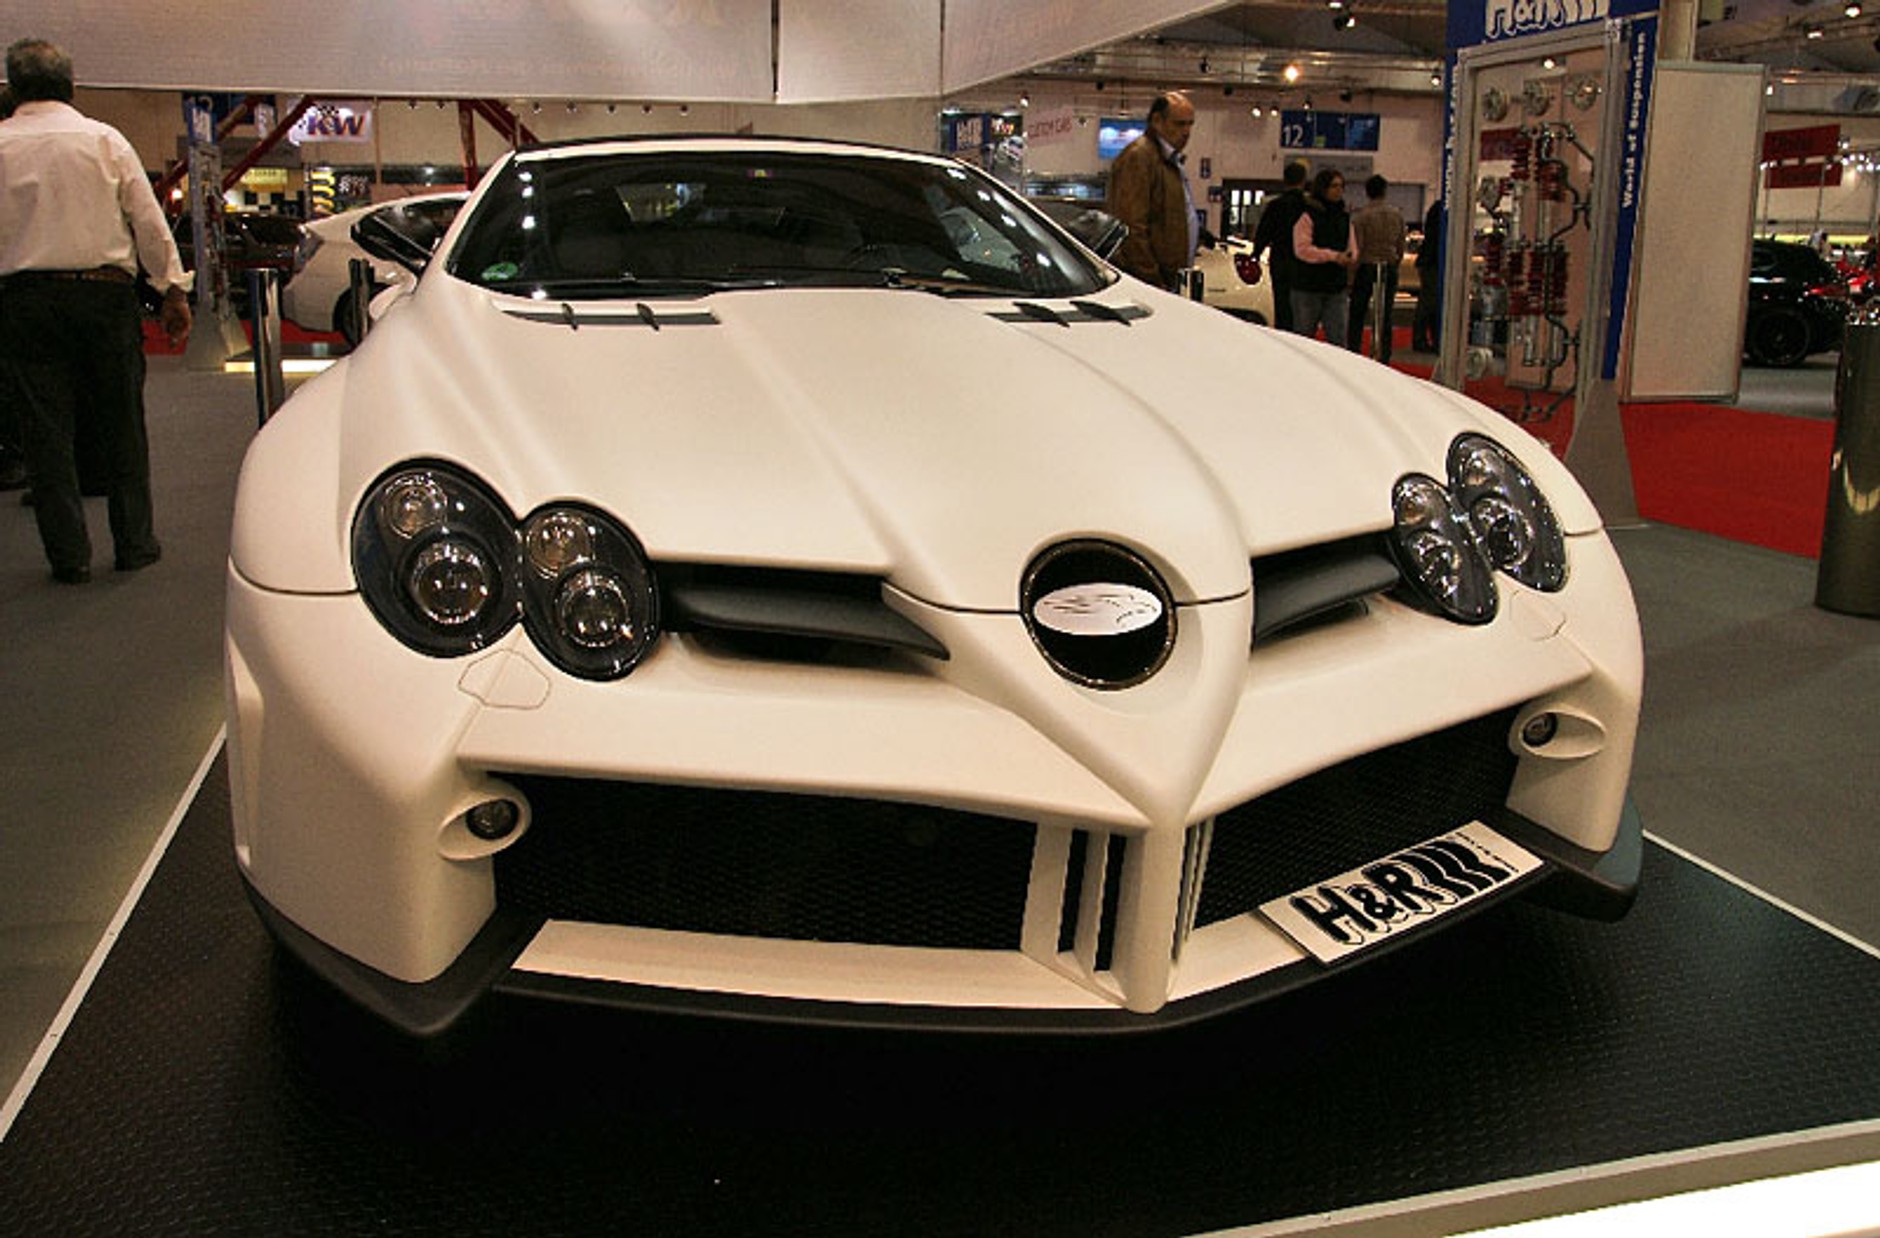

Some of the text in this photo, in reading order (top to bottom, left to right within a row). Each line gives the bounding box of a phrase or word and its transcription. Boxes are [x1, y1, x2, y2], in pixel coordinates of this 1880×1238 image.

[306, 114, 366, 136] KW
[1283, 125, 1304, 147] 12
[1627, 133, 1637, 151] of
[1621, 157, 1636, 208] World
[1289, 861, 1458, 945] H&R
